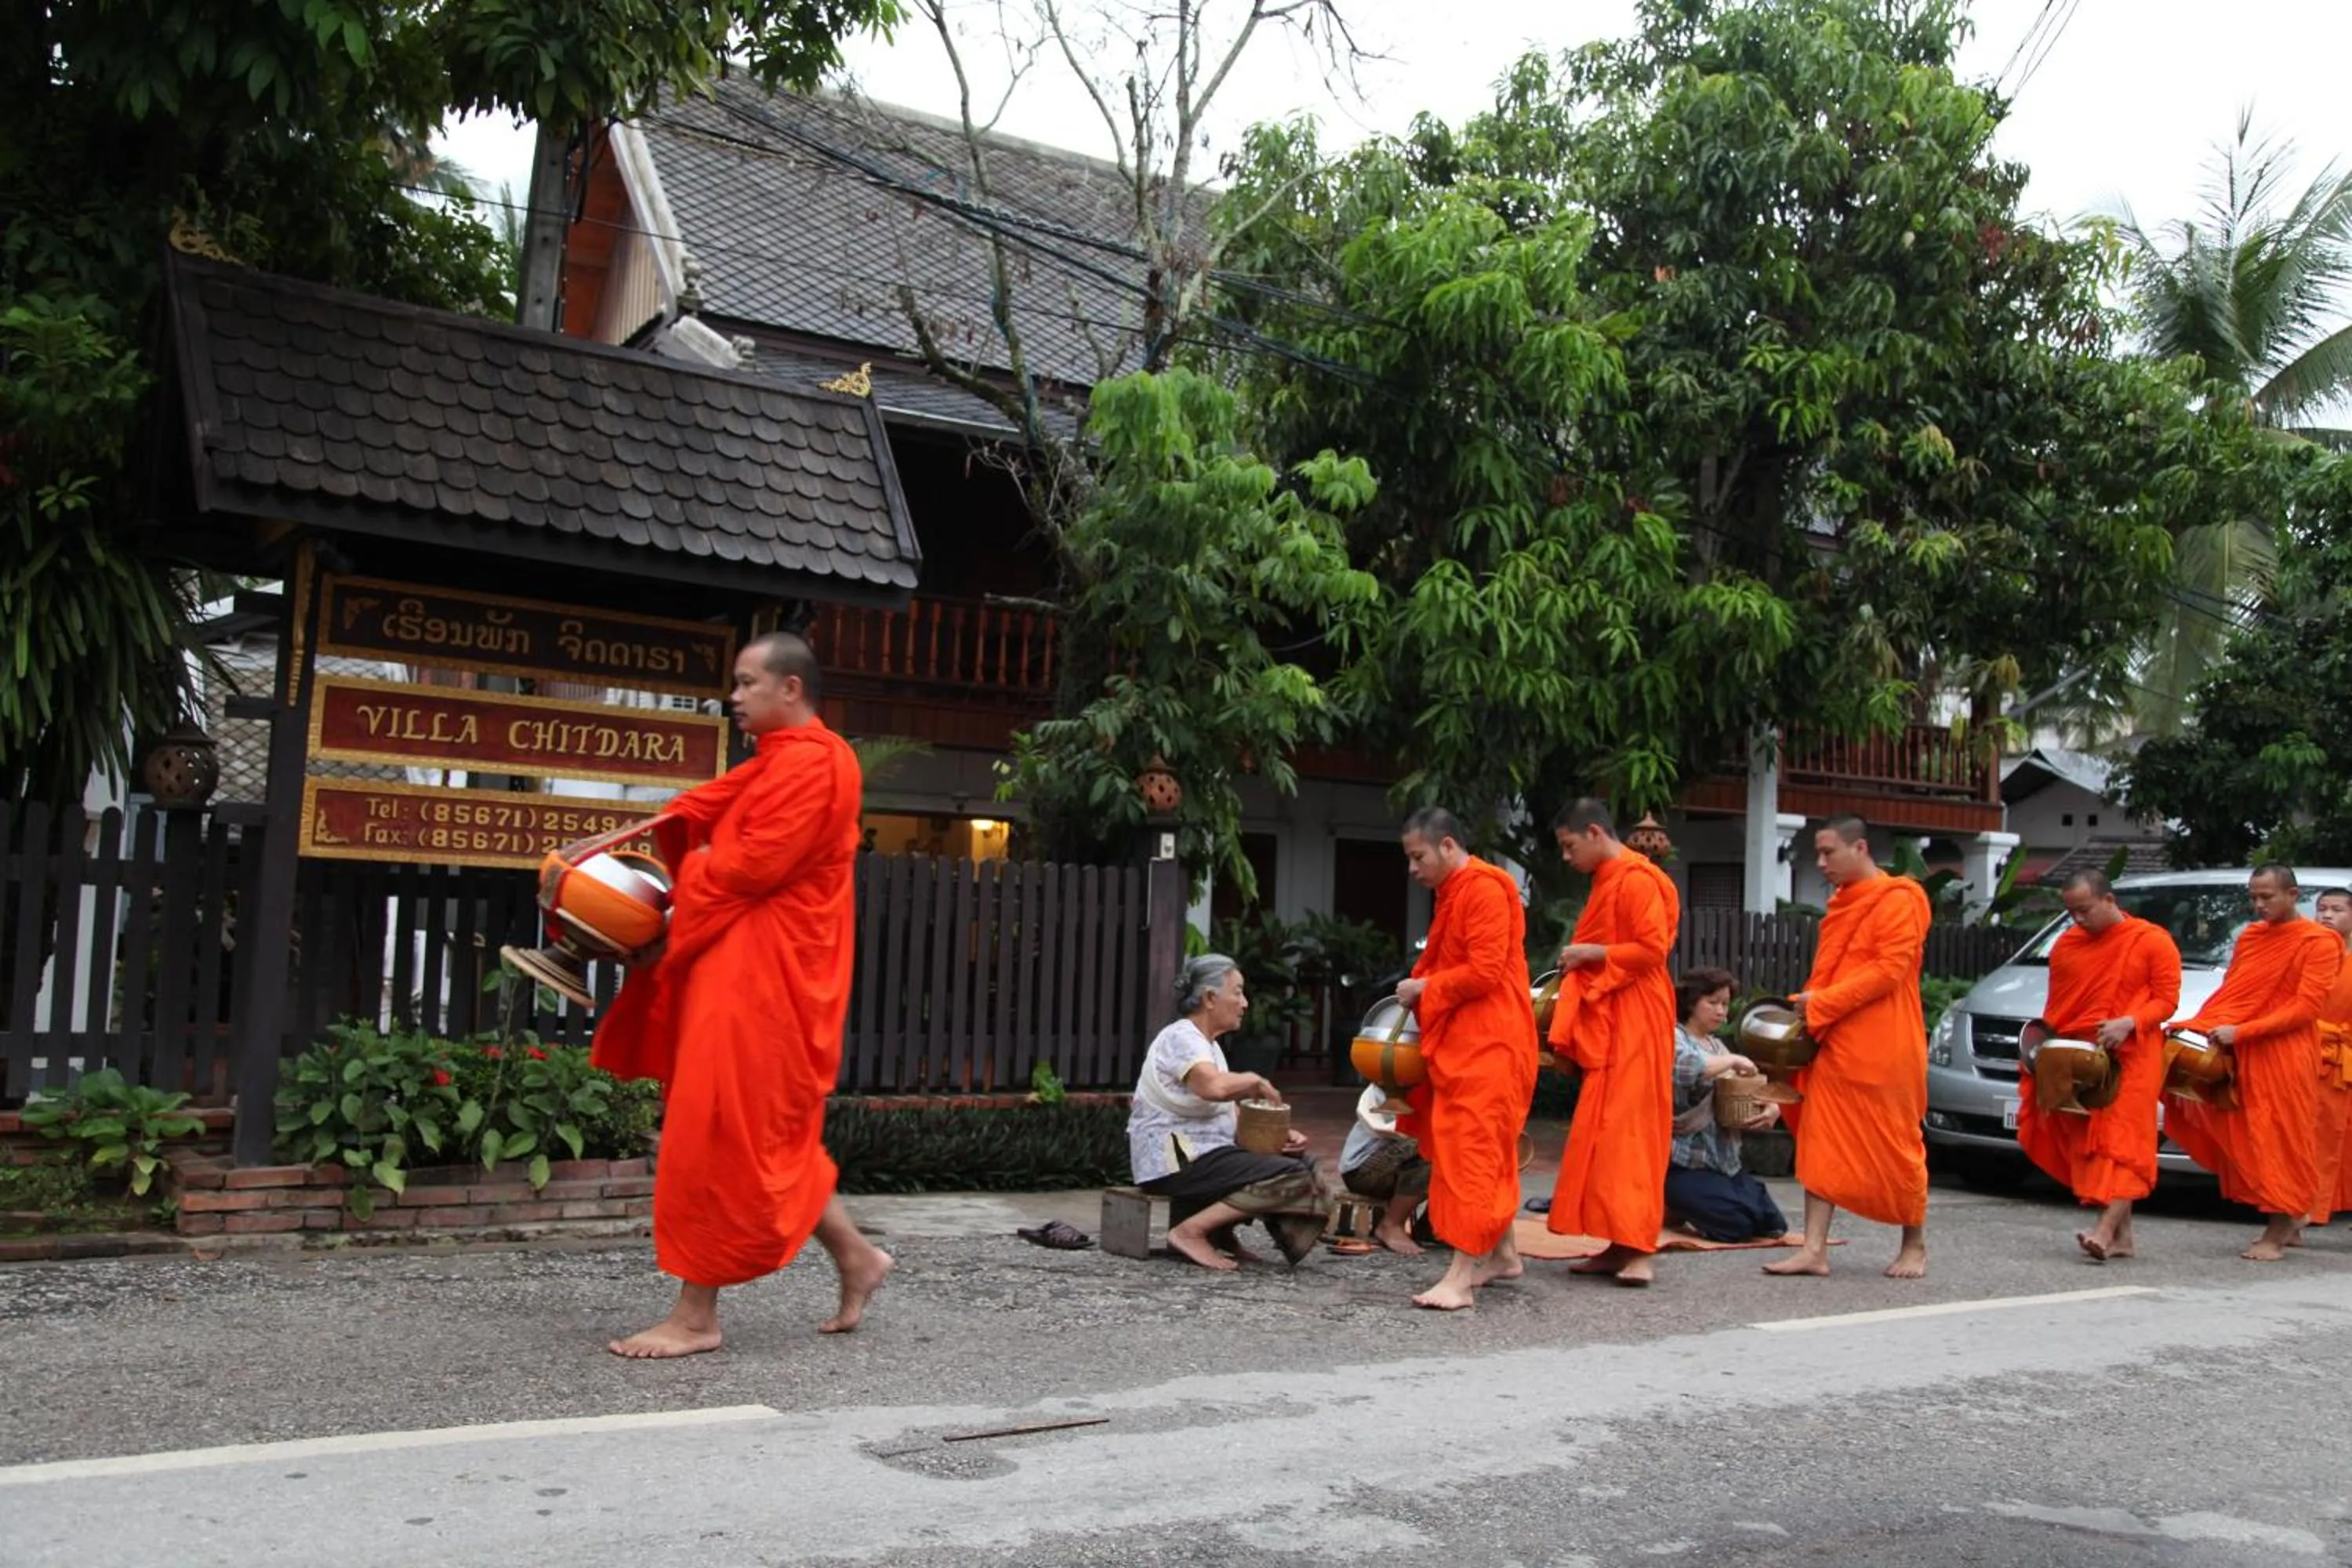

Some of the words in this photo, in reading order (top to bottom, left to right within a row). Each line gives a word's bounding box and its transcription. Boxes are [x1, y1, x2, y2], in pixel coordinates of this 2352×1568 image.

[357, 706, 478, 744] VILLA
[508, 719, 685, 762] CHITDARA
[365, 797, 408, 819] Tel:
[364, 822, 408, 845] Fax:
